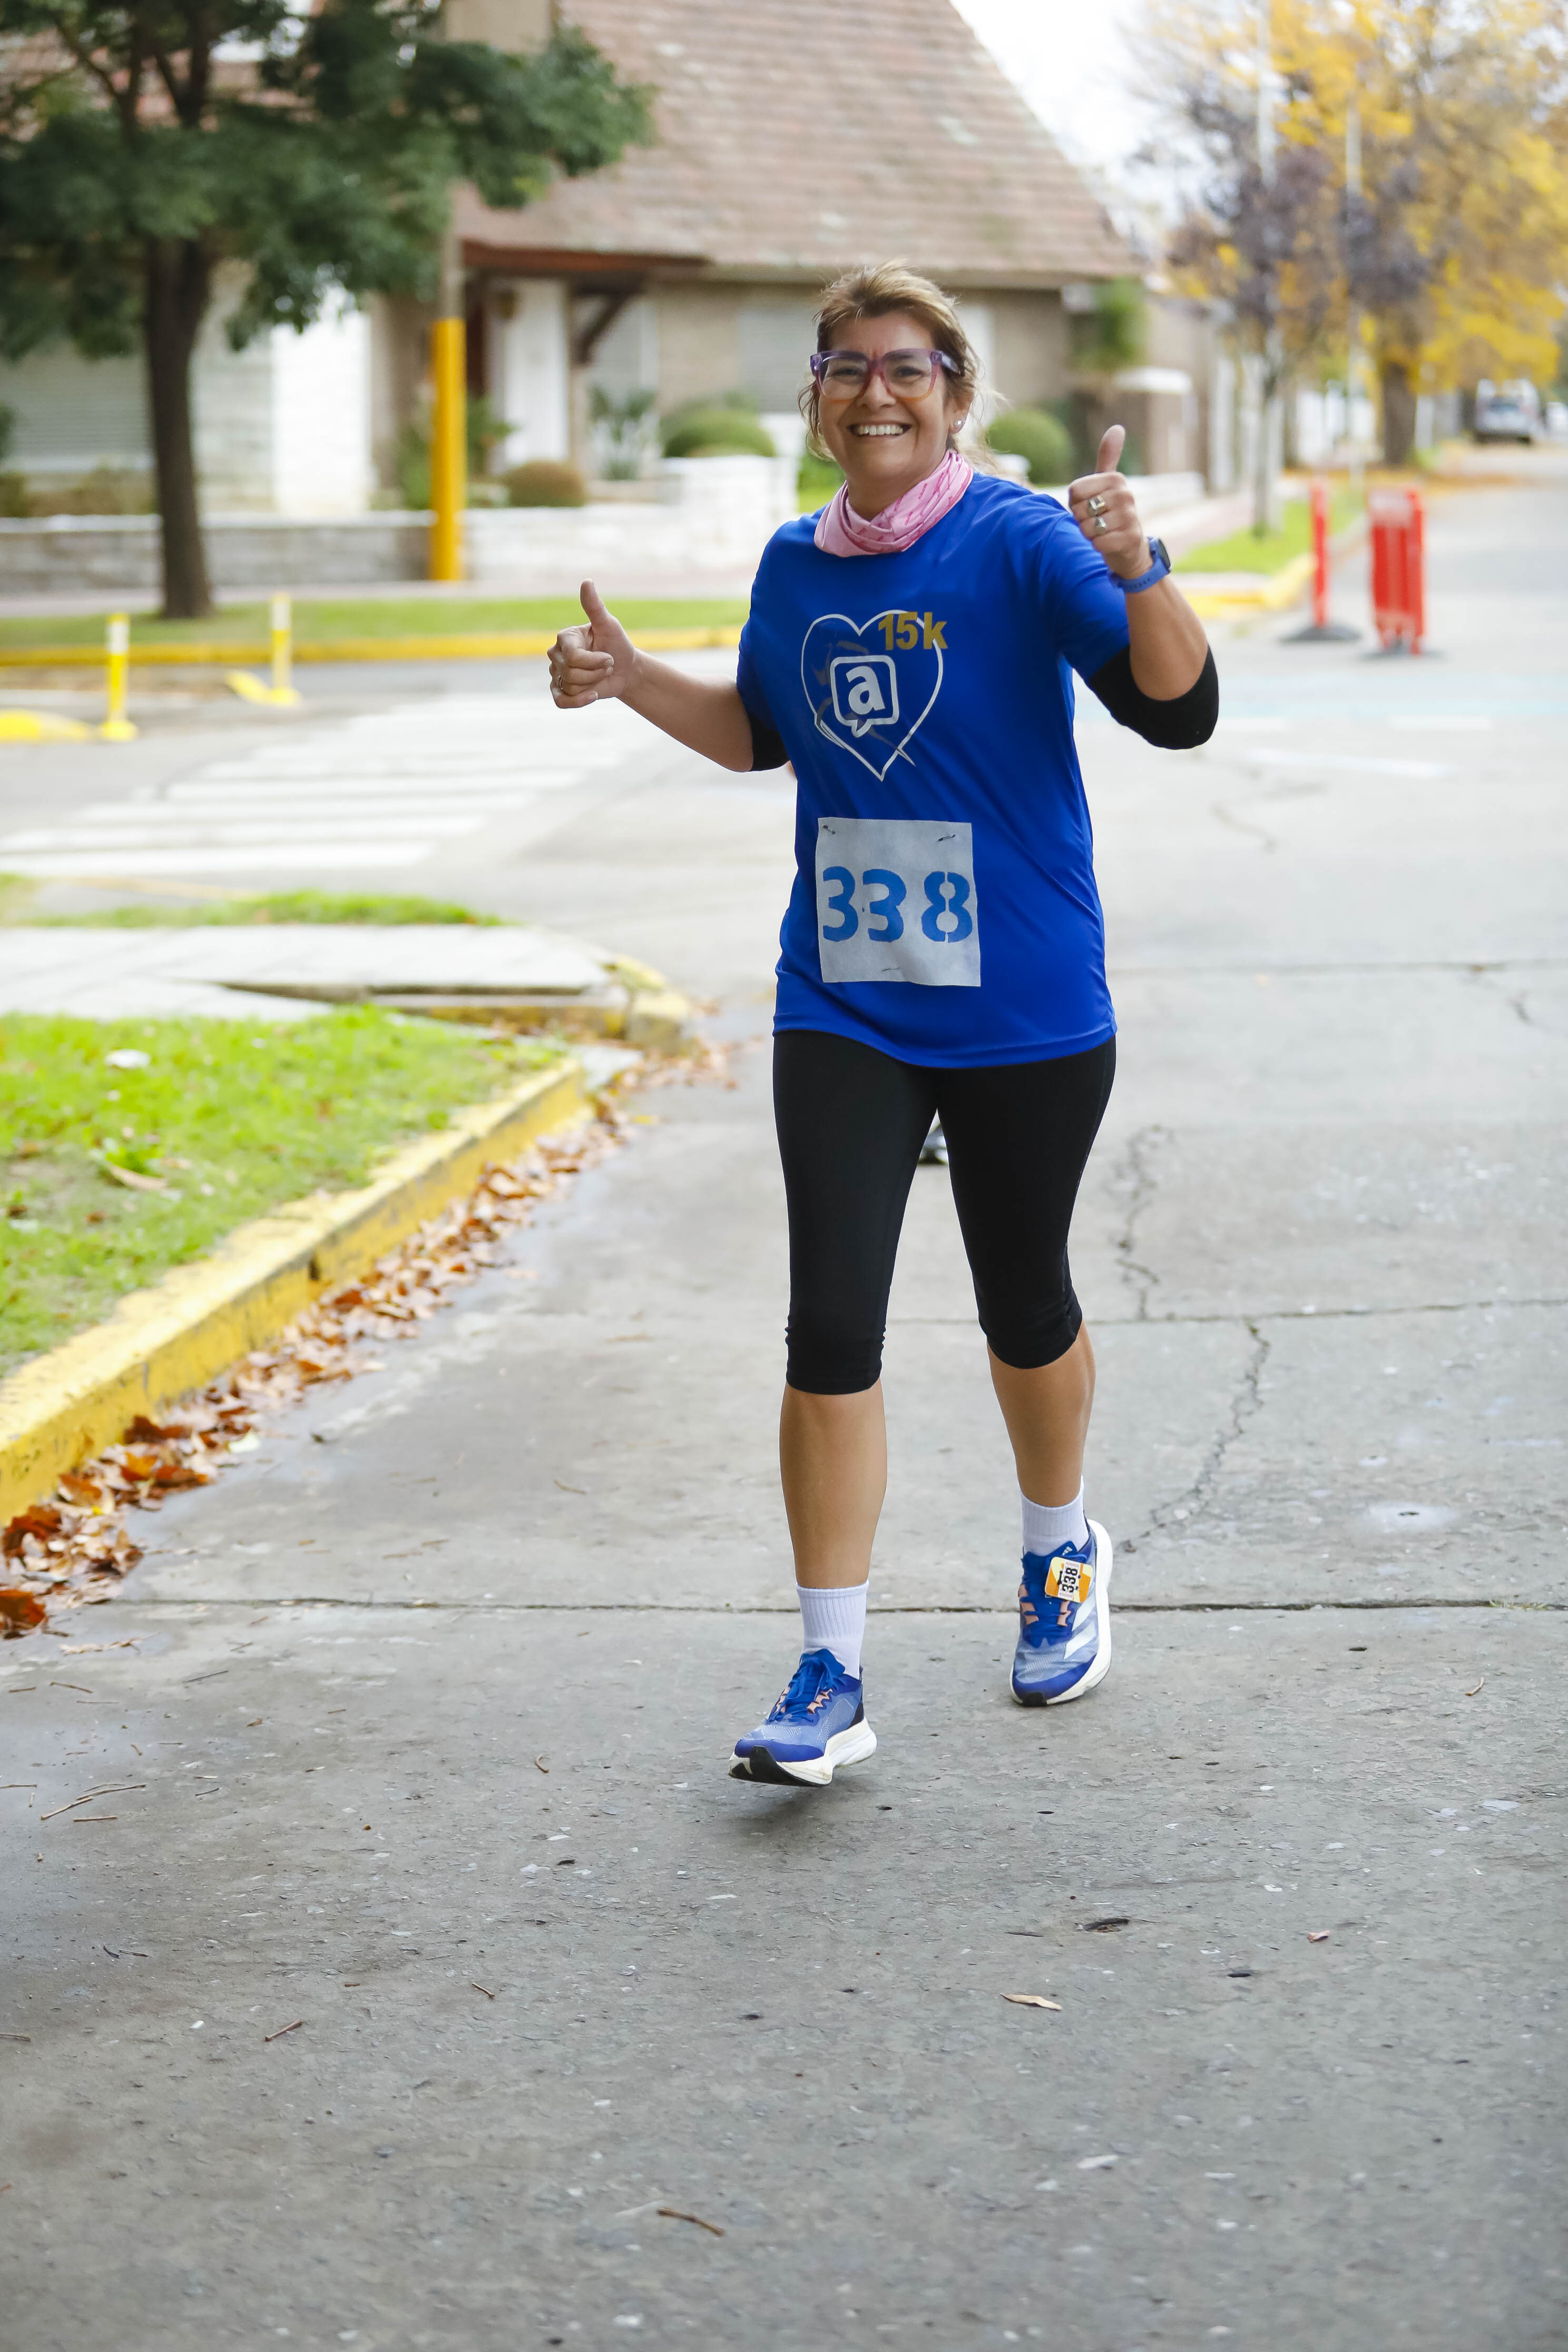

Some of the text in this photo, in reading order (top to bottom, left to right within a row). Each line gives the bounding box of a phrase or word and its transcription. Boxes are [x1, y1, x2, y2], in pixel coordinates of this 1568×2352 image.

[878, 611, 948, 651] 15k
[845, 665, 886, 715] a
[822, 866, 973, 944] 338
[1062, 1567, 1078, 1593] 338
